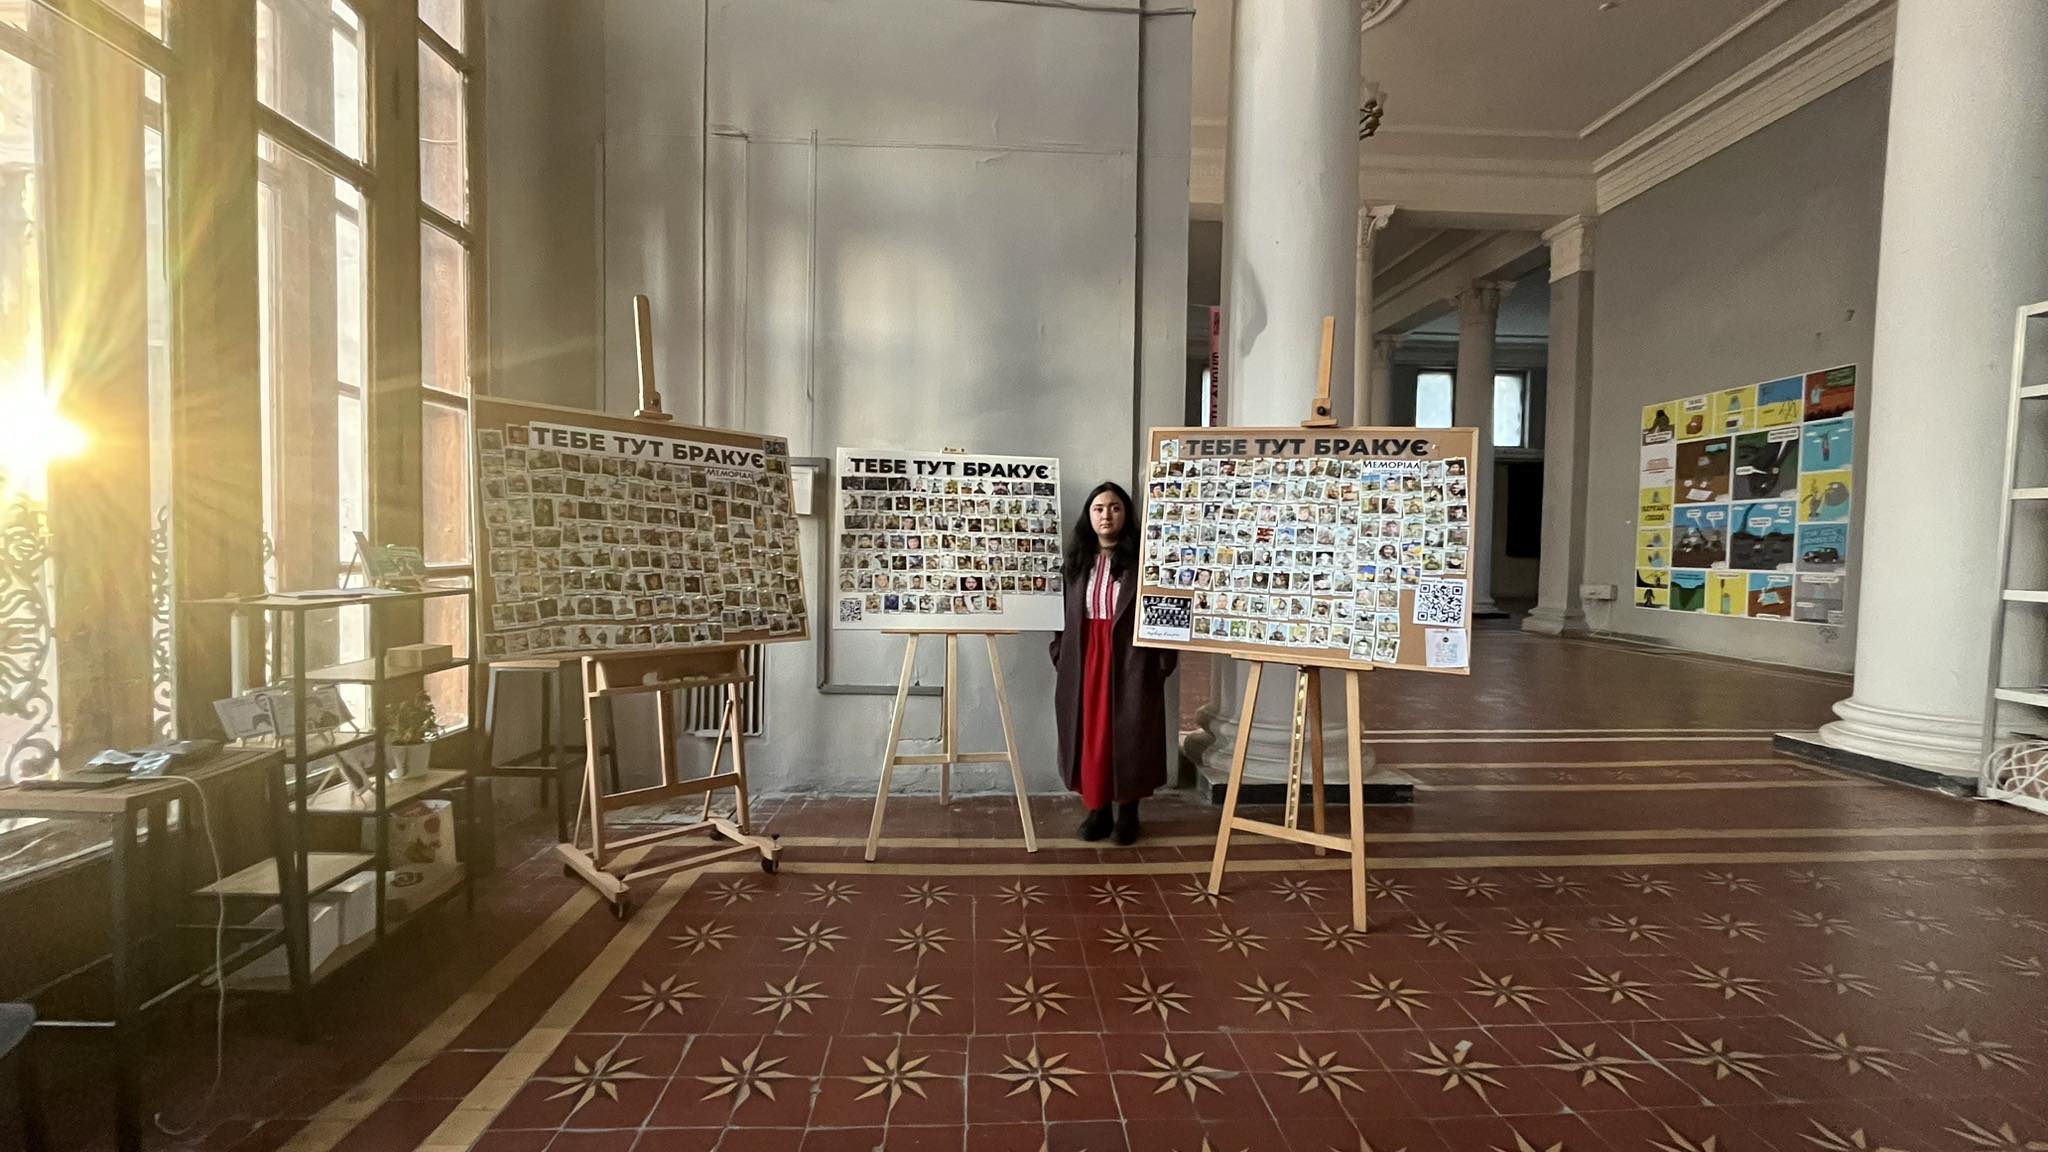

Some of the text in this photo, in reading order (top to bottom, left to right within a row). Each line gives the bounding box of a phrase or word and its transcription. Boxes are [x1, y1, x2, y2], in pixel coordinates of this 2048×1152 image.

[531, 427, 764, 469] ТЕБЕ ТУТ БРАКУЄ
[1186, 439, 1429, 456] ТЕБЕ ТУТ БРАКУЄ
[850, 458, 1049, 479] ТЕБЕ ТУТ БРАКУЄ
